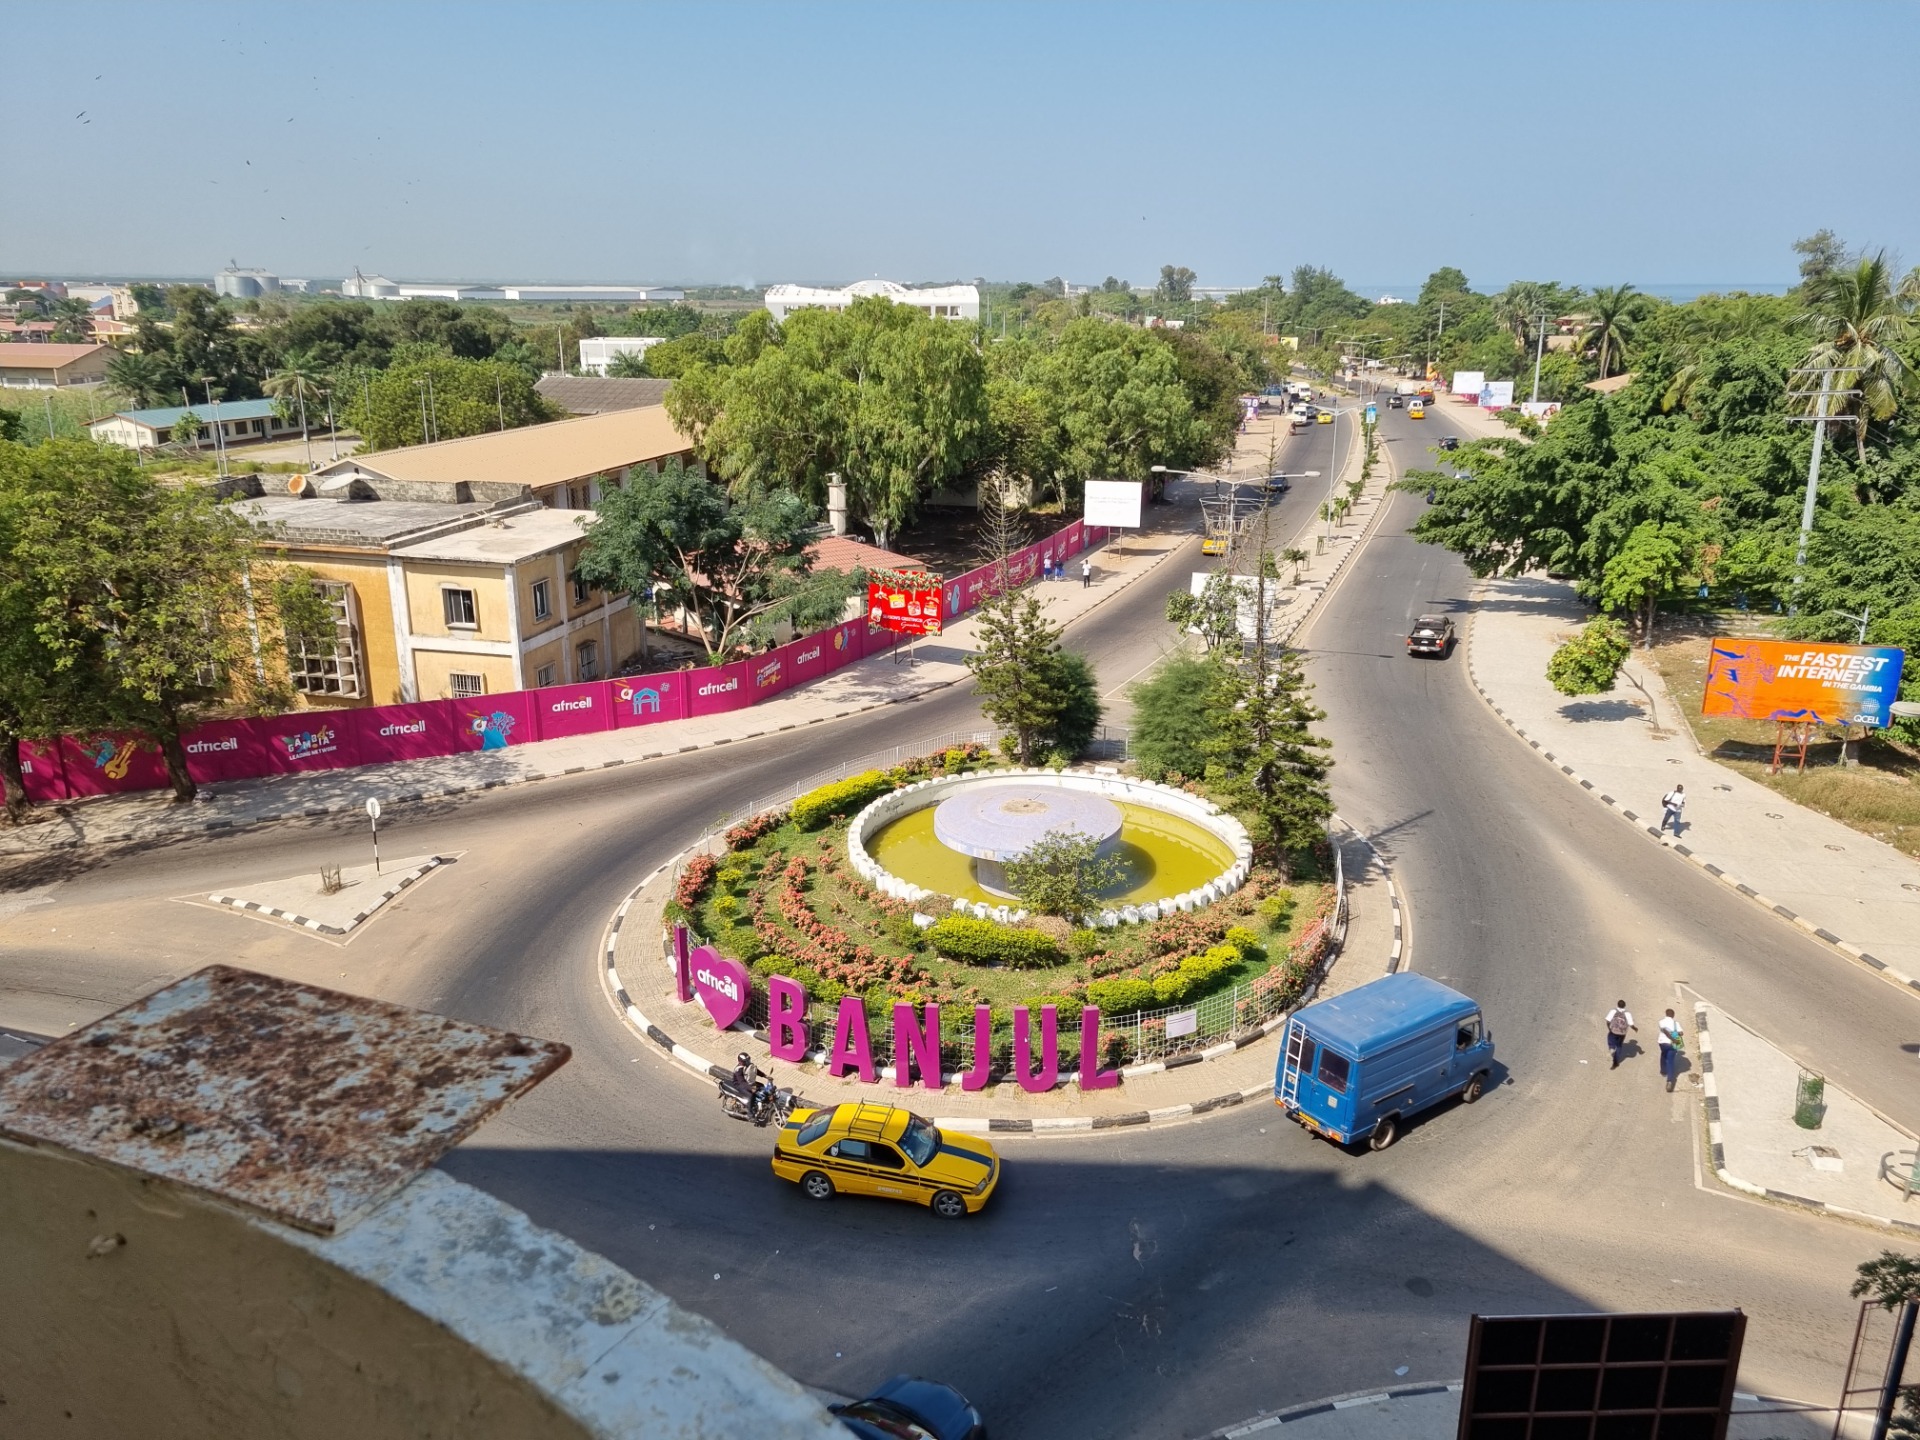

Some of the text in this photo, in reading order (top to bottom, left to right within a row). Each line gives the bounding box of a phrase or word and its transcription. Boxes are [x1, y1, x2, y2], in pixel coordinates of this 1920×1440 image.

[797, 646, 820, 664] africell
[1784, 652, 1889, 672] THE FASTEST
[1776, 665, 1869, 684] INTERNET
[698, 677, 738, 695] africell
[1833, 681, 1849, 689] THE
[1849, 683, 1883, 693] GAMBIA
[552, 696, 592, 712] africell
[380, 720, 426, 736] africell
[1854, 714, 1880, 725] QCELL
[187, 737, 238, 753] africell
[674, 926, 691, 1003] I
[697, 969, 738, 1002] africell
[769, 974, 1119, 1092] BANJUL
